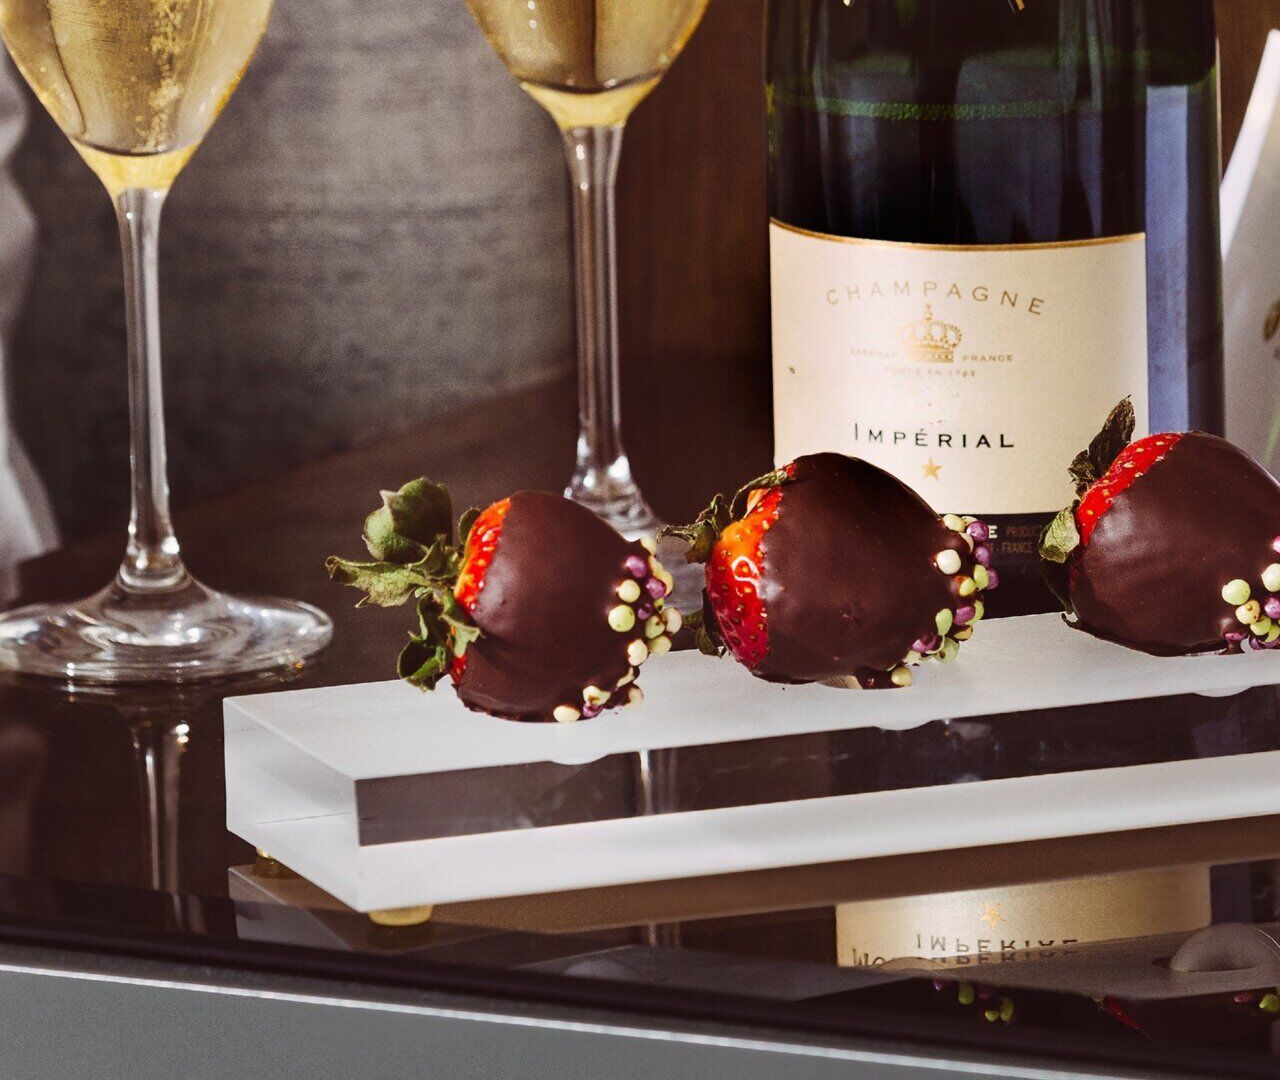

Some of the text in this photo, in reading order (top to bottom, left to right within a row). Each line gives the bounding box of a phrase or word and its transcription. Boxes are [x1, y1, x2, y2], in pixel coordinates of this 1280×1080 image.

[826, 279, 1047, 316] CHAMPAGNE
[962, 354, 1014, 362] FRANCE
[853, 421, 1015, 449] IMPÉRIAL
